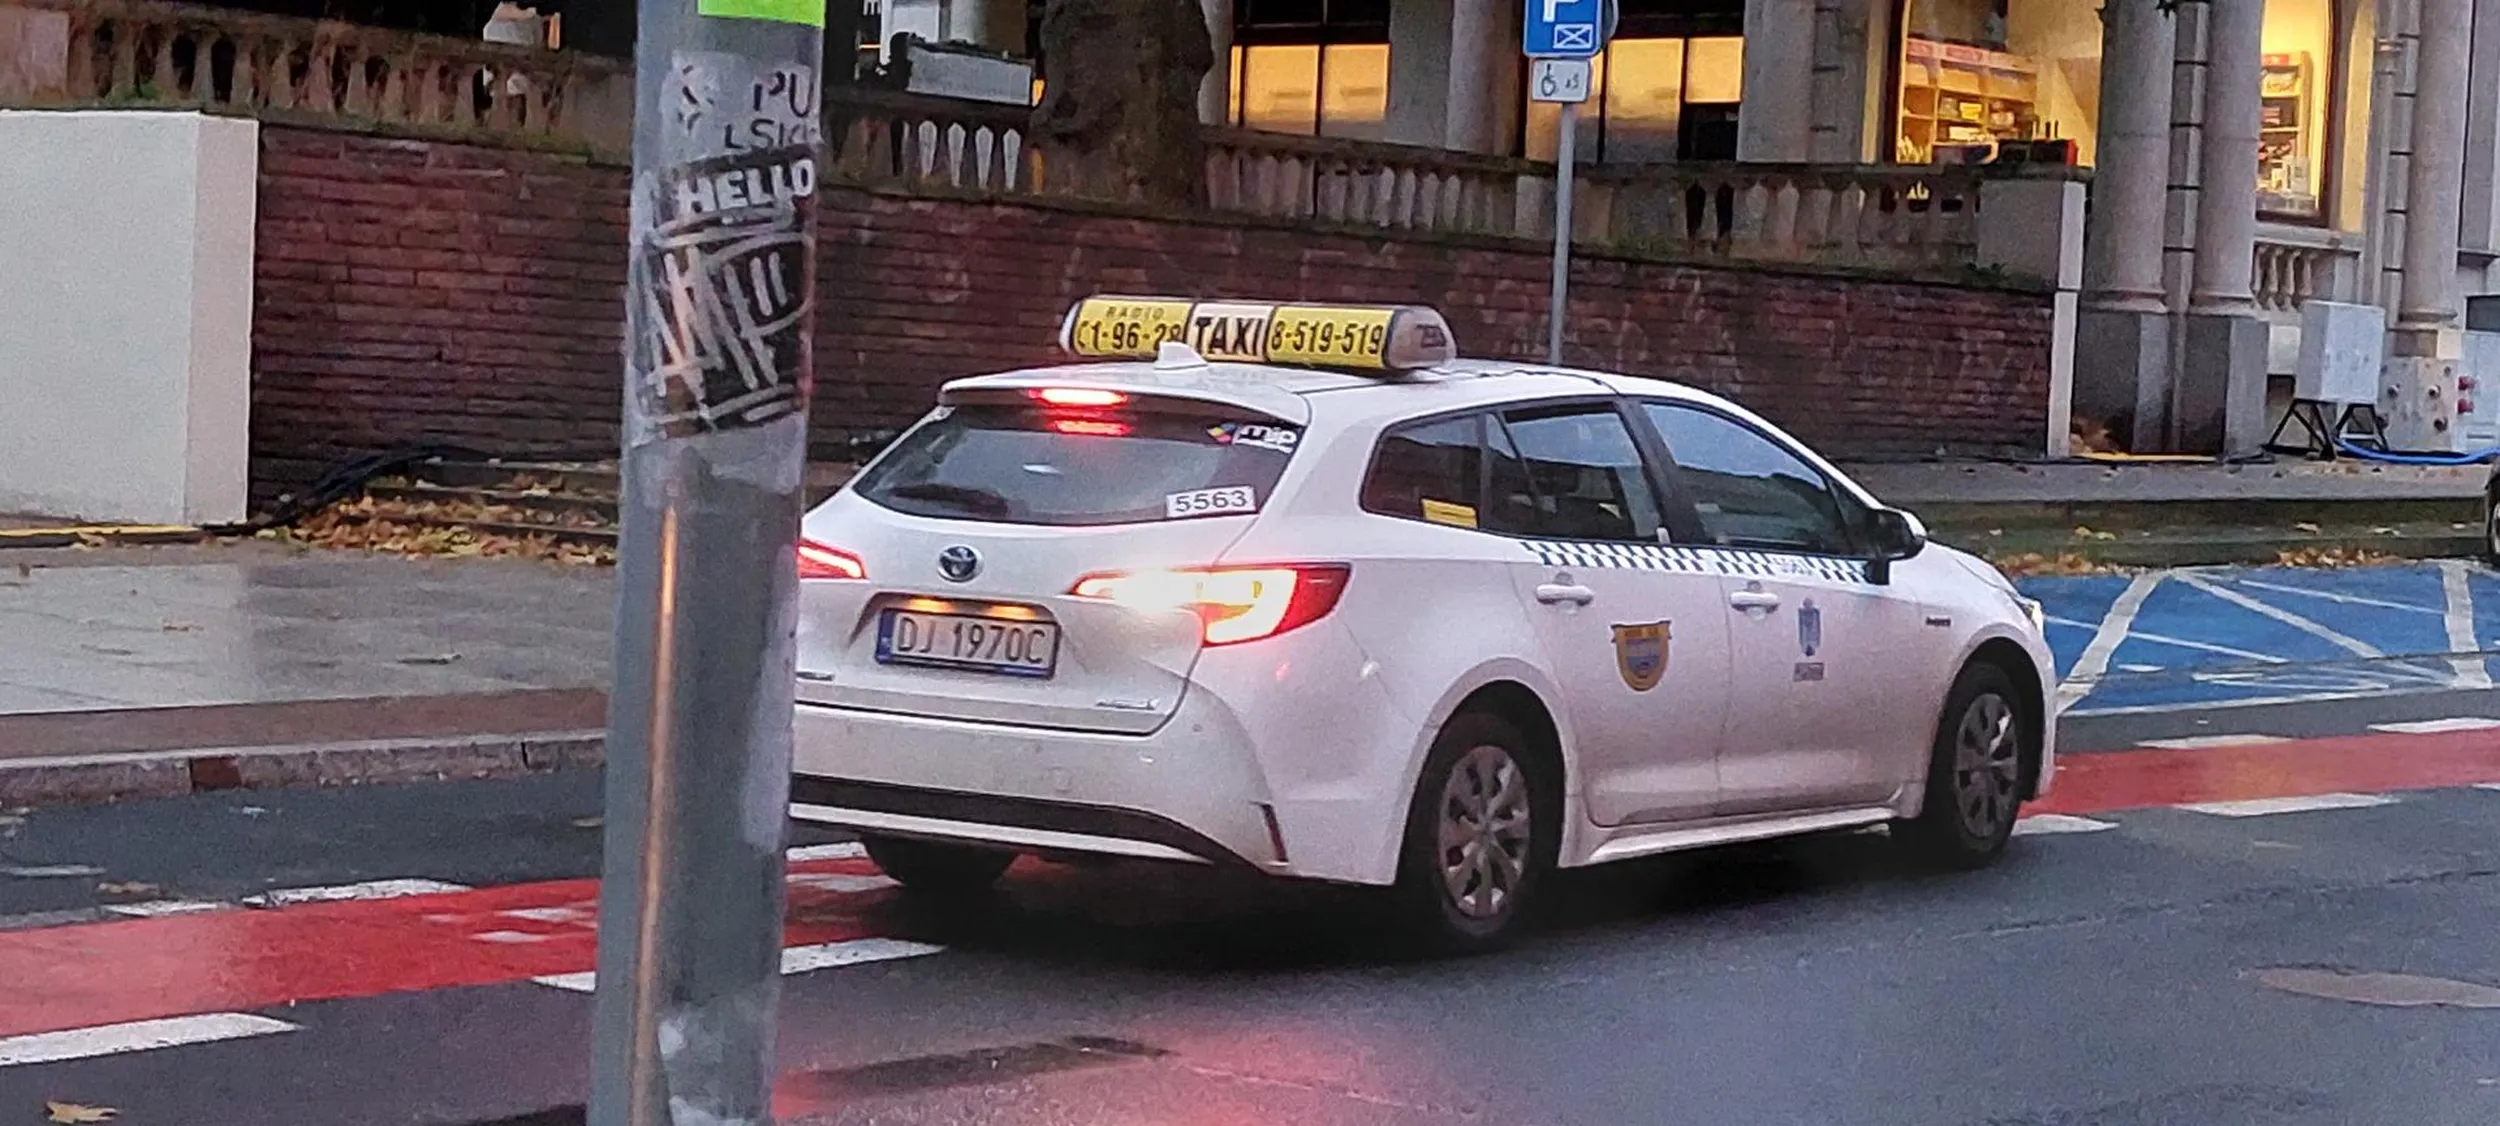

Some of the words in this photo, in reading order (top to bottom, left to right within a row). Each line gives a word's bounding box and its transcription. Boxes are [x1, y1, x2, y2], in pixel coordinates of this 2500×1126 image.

[677, 158, 815, 213] HELLO
[1105, 306, 1165, 320] RADIO
[1195, 316, 1263, 356] TAXI
[1271, 320, 1384, 355] 8-519-519
[1174, 489, 1248, 513] 5563
[898, 616, 937, 653] DJ
[953, 621, 1047, 664] 1970C
